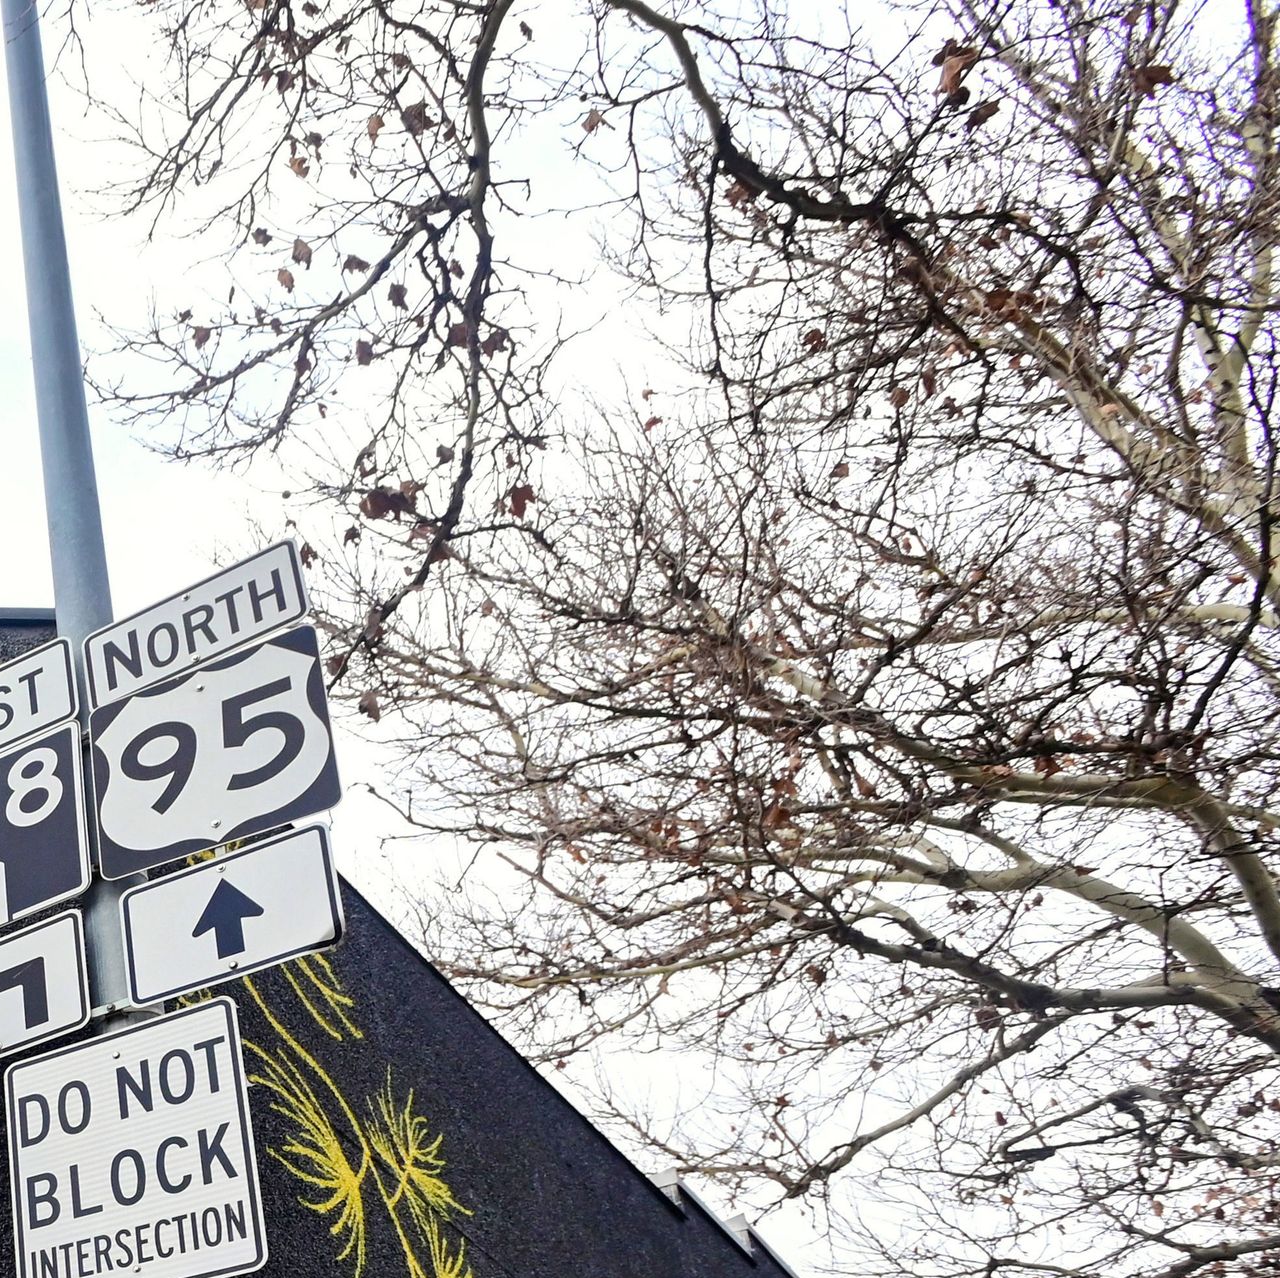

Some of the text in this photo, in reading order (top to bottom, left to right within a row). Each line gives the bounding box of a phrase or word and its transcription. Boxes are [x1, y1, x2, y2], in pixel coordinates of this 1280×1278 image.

[102, 569, 288, 691] NORTH
[5, 747, 63, 827] 8
[120, 677, 305, 815] 95
[18, 1036, 225, 1148] DO NOT
[27, 1122, 238, 1229] BLOCK
